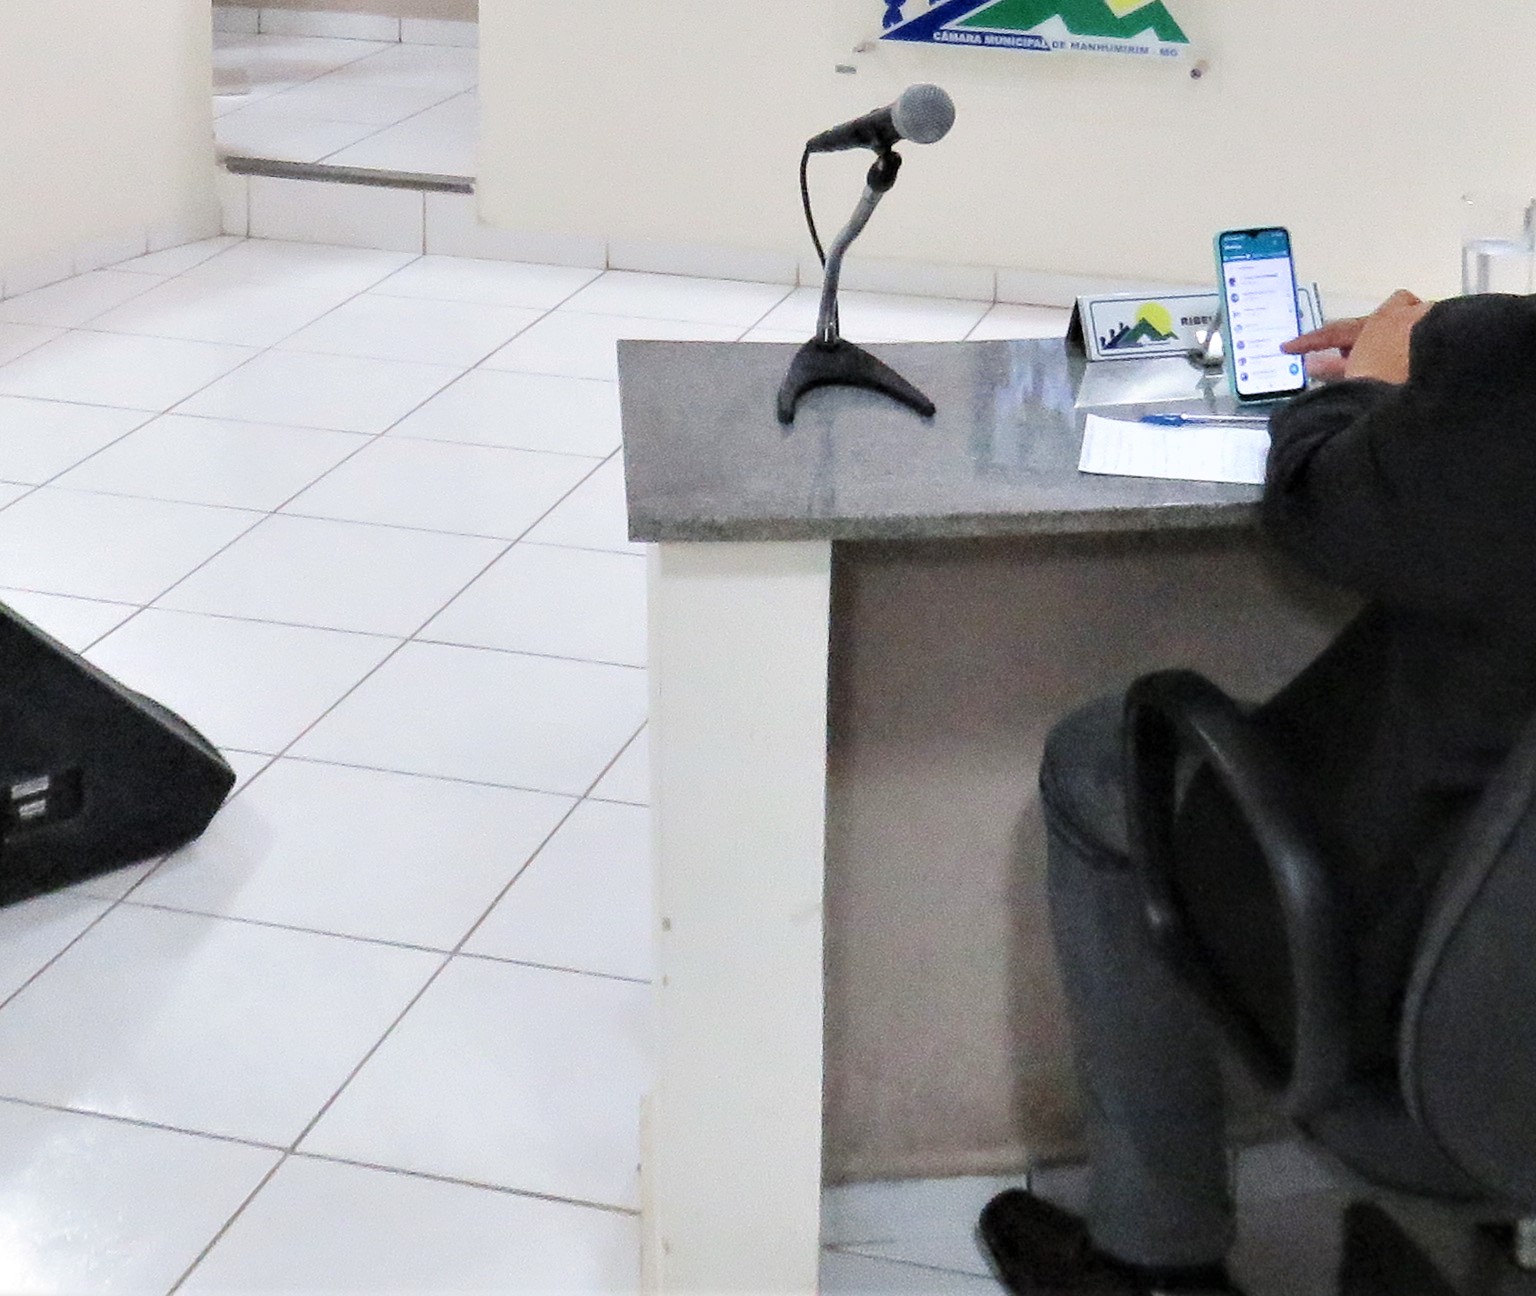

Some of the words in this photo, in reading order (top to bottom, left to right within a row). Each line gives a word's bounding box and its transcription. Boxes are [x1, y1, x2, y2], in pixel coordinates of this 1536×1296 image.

[932, 30, 982, 45] CÂMARA
[983, 35, 1050, 49] MUNICIPAL
[1051, 40, 1066, 49] DE
[1070, 42, 1149, 54] MANHUMIRIM
